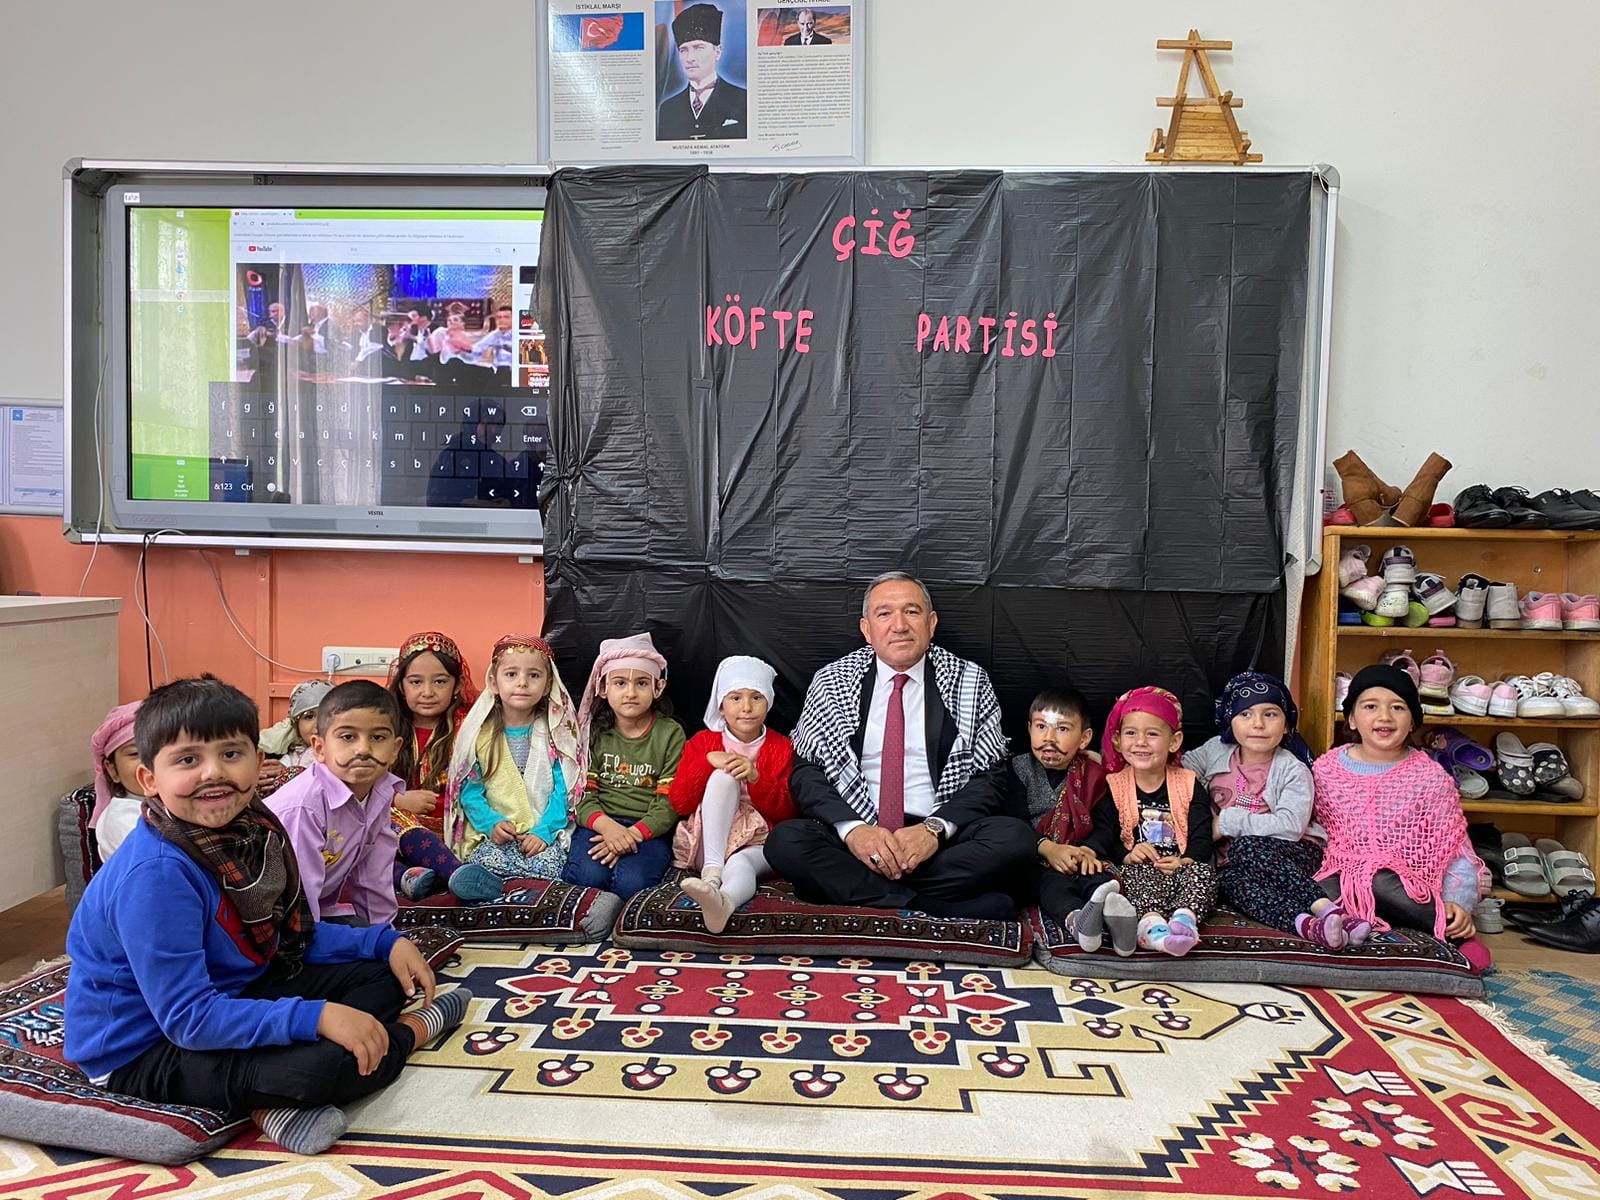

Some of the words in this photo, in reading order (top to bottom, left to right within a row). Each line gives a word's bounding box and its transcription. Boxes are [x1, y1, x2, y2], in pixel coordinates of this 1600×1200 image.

[832, 208, 915, 262] ÇİĞ
[705, 294, 814, 353] KÖFTE
[916, 311, 1058, 358] PARTİSİ
[523, 435, 543, 443] Enter
[241, 483, 254, 491] Ctrl
